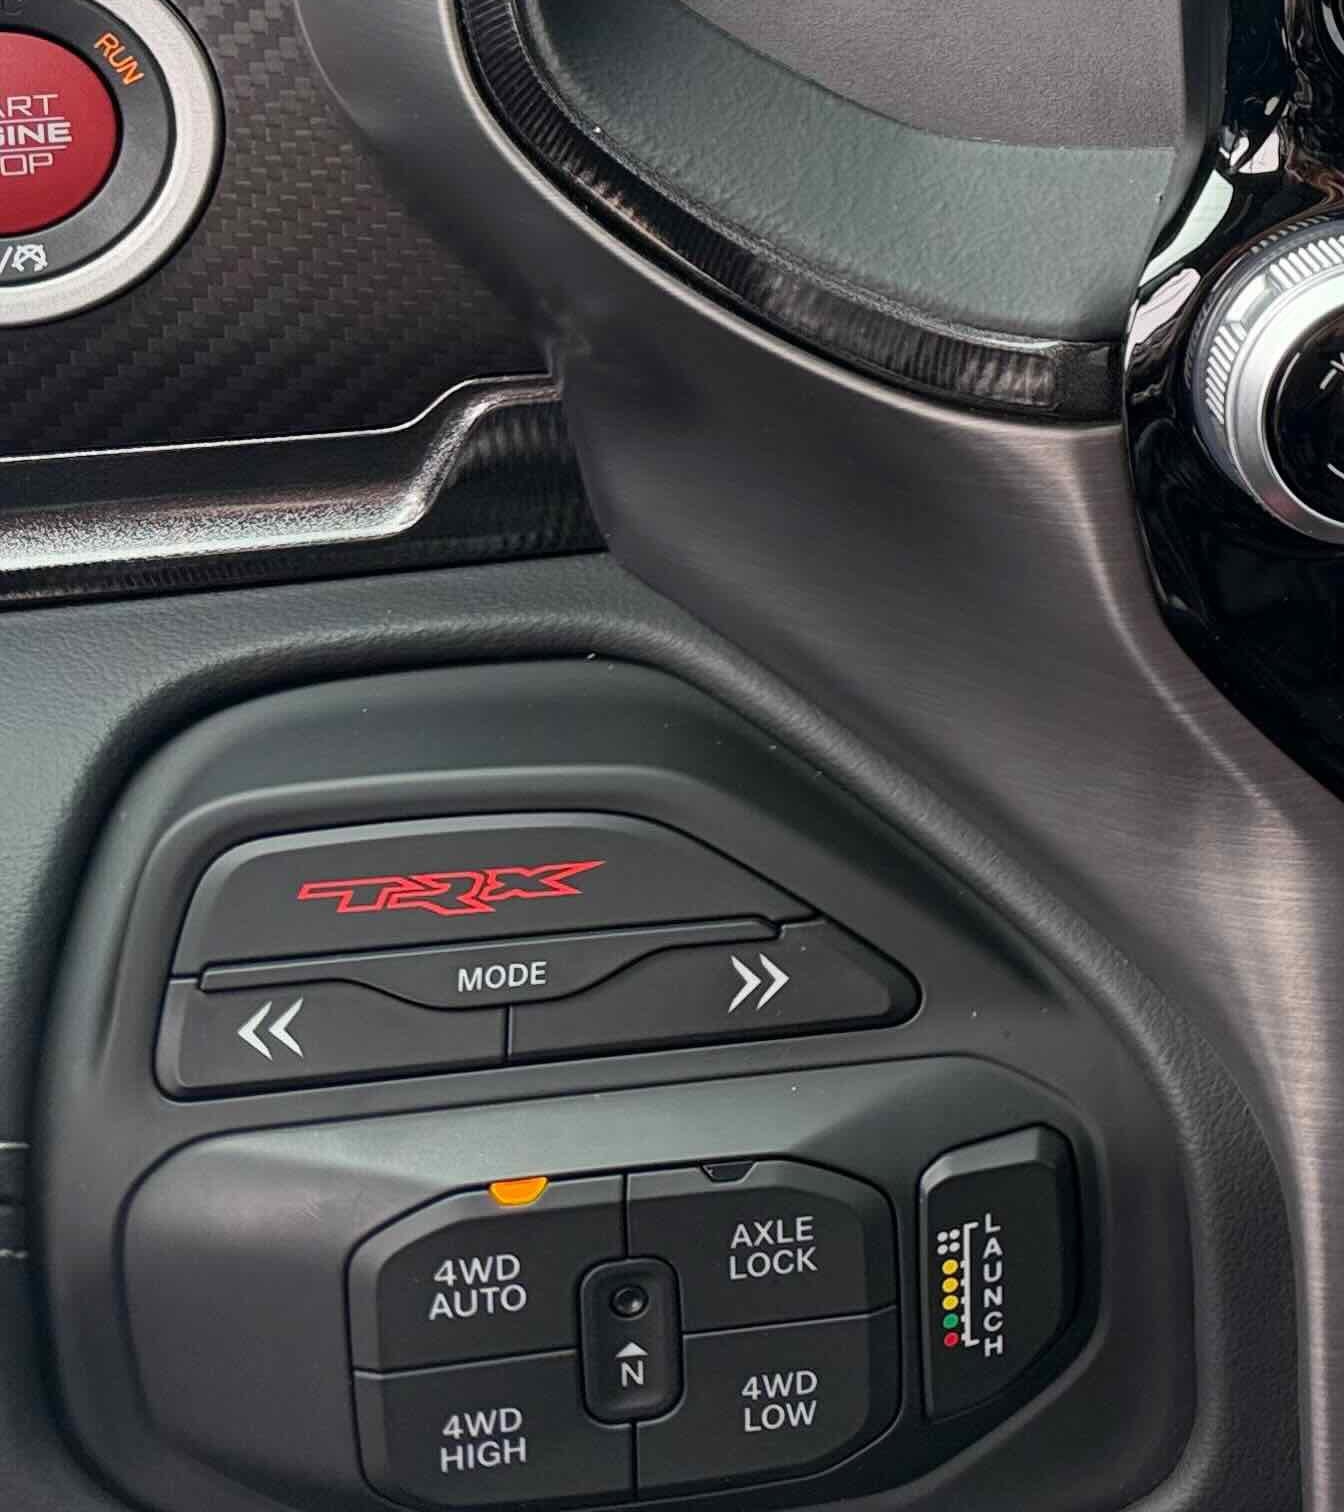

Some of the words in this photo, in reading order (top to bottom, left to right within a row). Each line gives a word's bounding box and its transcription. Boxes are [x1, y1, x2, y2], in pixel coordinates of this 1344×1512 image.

[94, 32, 144, 86] RUN
[297, 860, 606, 915] TRX
[457, 961, 547, 992] MODE
[731, 1216, 815, 1247] AXLE
[434, 1254, 521, 1288] 4WD
[730, 1247, 818, 1279] LOCK
[983, 1213, 1003, 1357] LAUNCH
[428, 1284, 527, 1321] AUTO
[620, 1360, 645, 1387] N
[742, 1370, 818, 1402] 4WD
[442, 1407, 523, 1440] 4WD
[743, 1400, 818, 1433] LOW
[440, 1436, 527, 1473] HIGH
